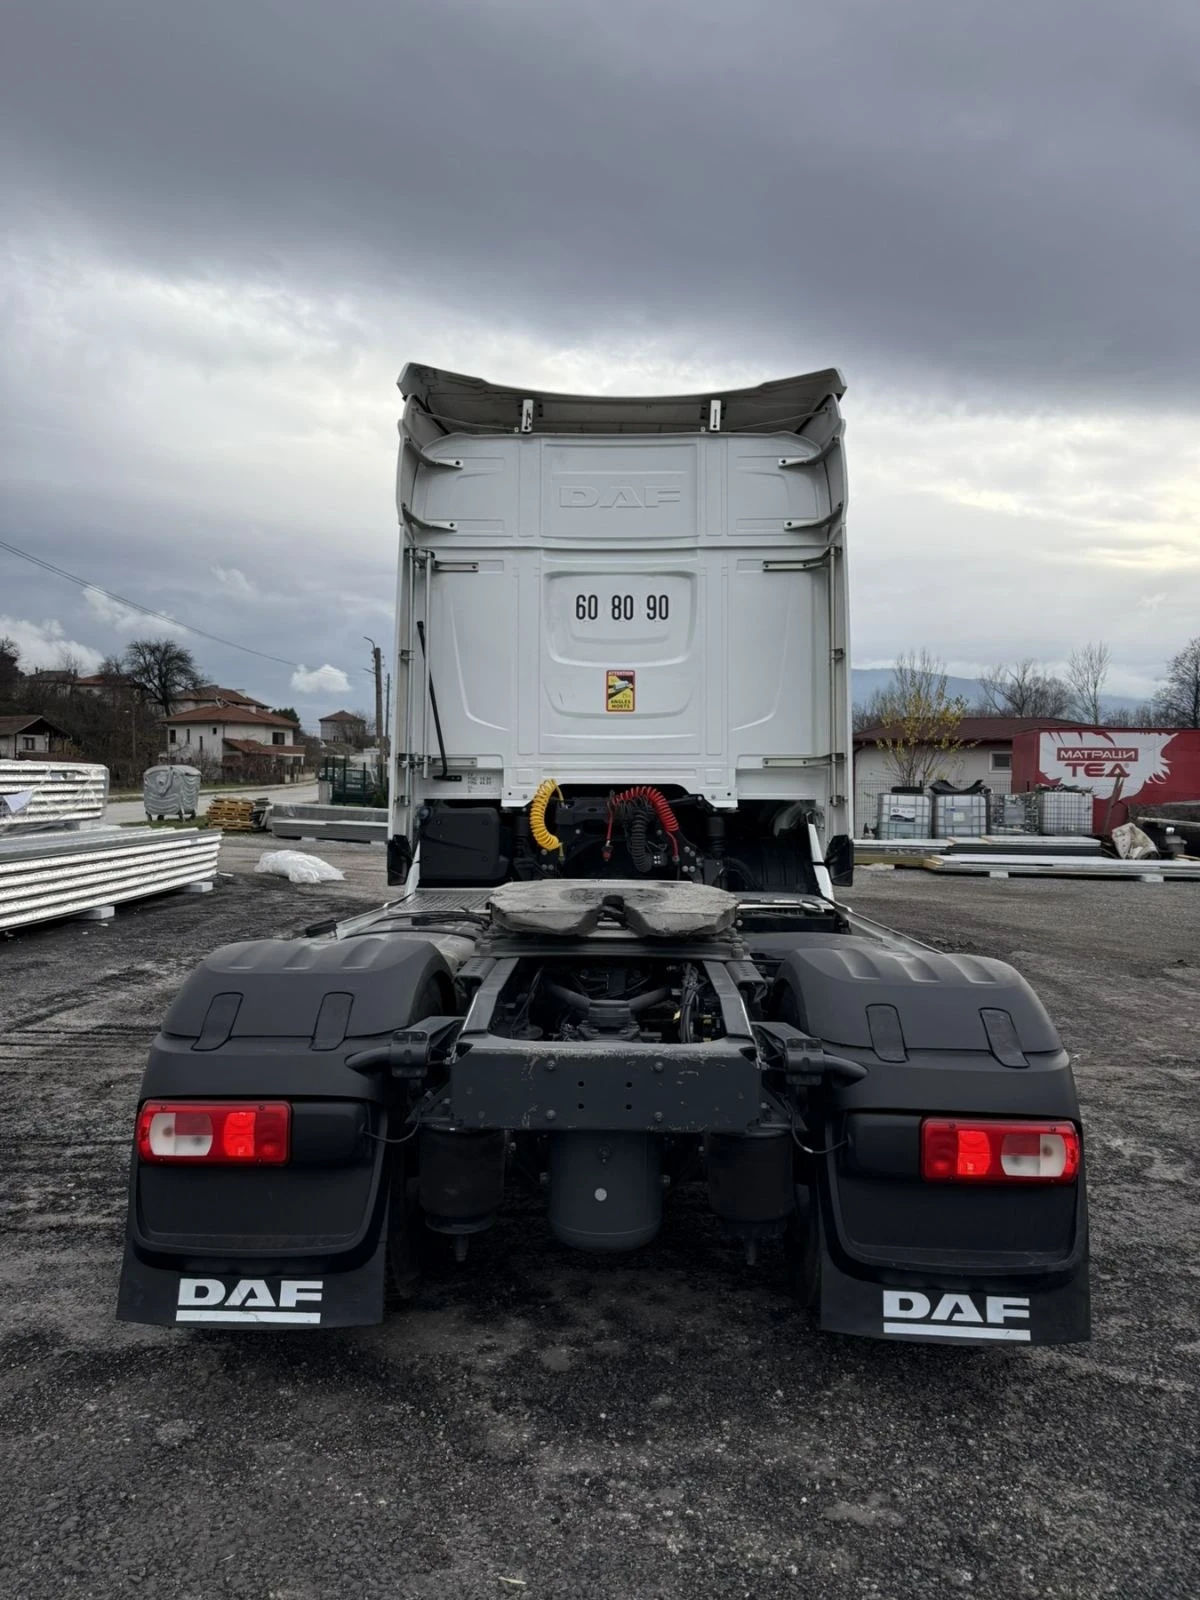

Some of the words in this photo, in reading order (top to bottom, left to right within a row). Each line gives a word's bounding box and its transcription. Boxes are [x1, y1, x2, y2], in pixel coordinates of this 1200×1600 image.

[559, 485, 681, 509] DAF
[576, 594, 598, 620] 60
[611, 594, 634, 621] 80
[646, 594, 669, 621] 90
[1060, 750, 1135, 759] МАТРАЦИ
[177, 1278, 323, 1307] DAF
[883, 1290, 1030, 1324] DAF
